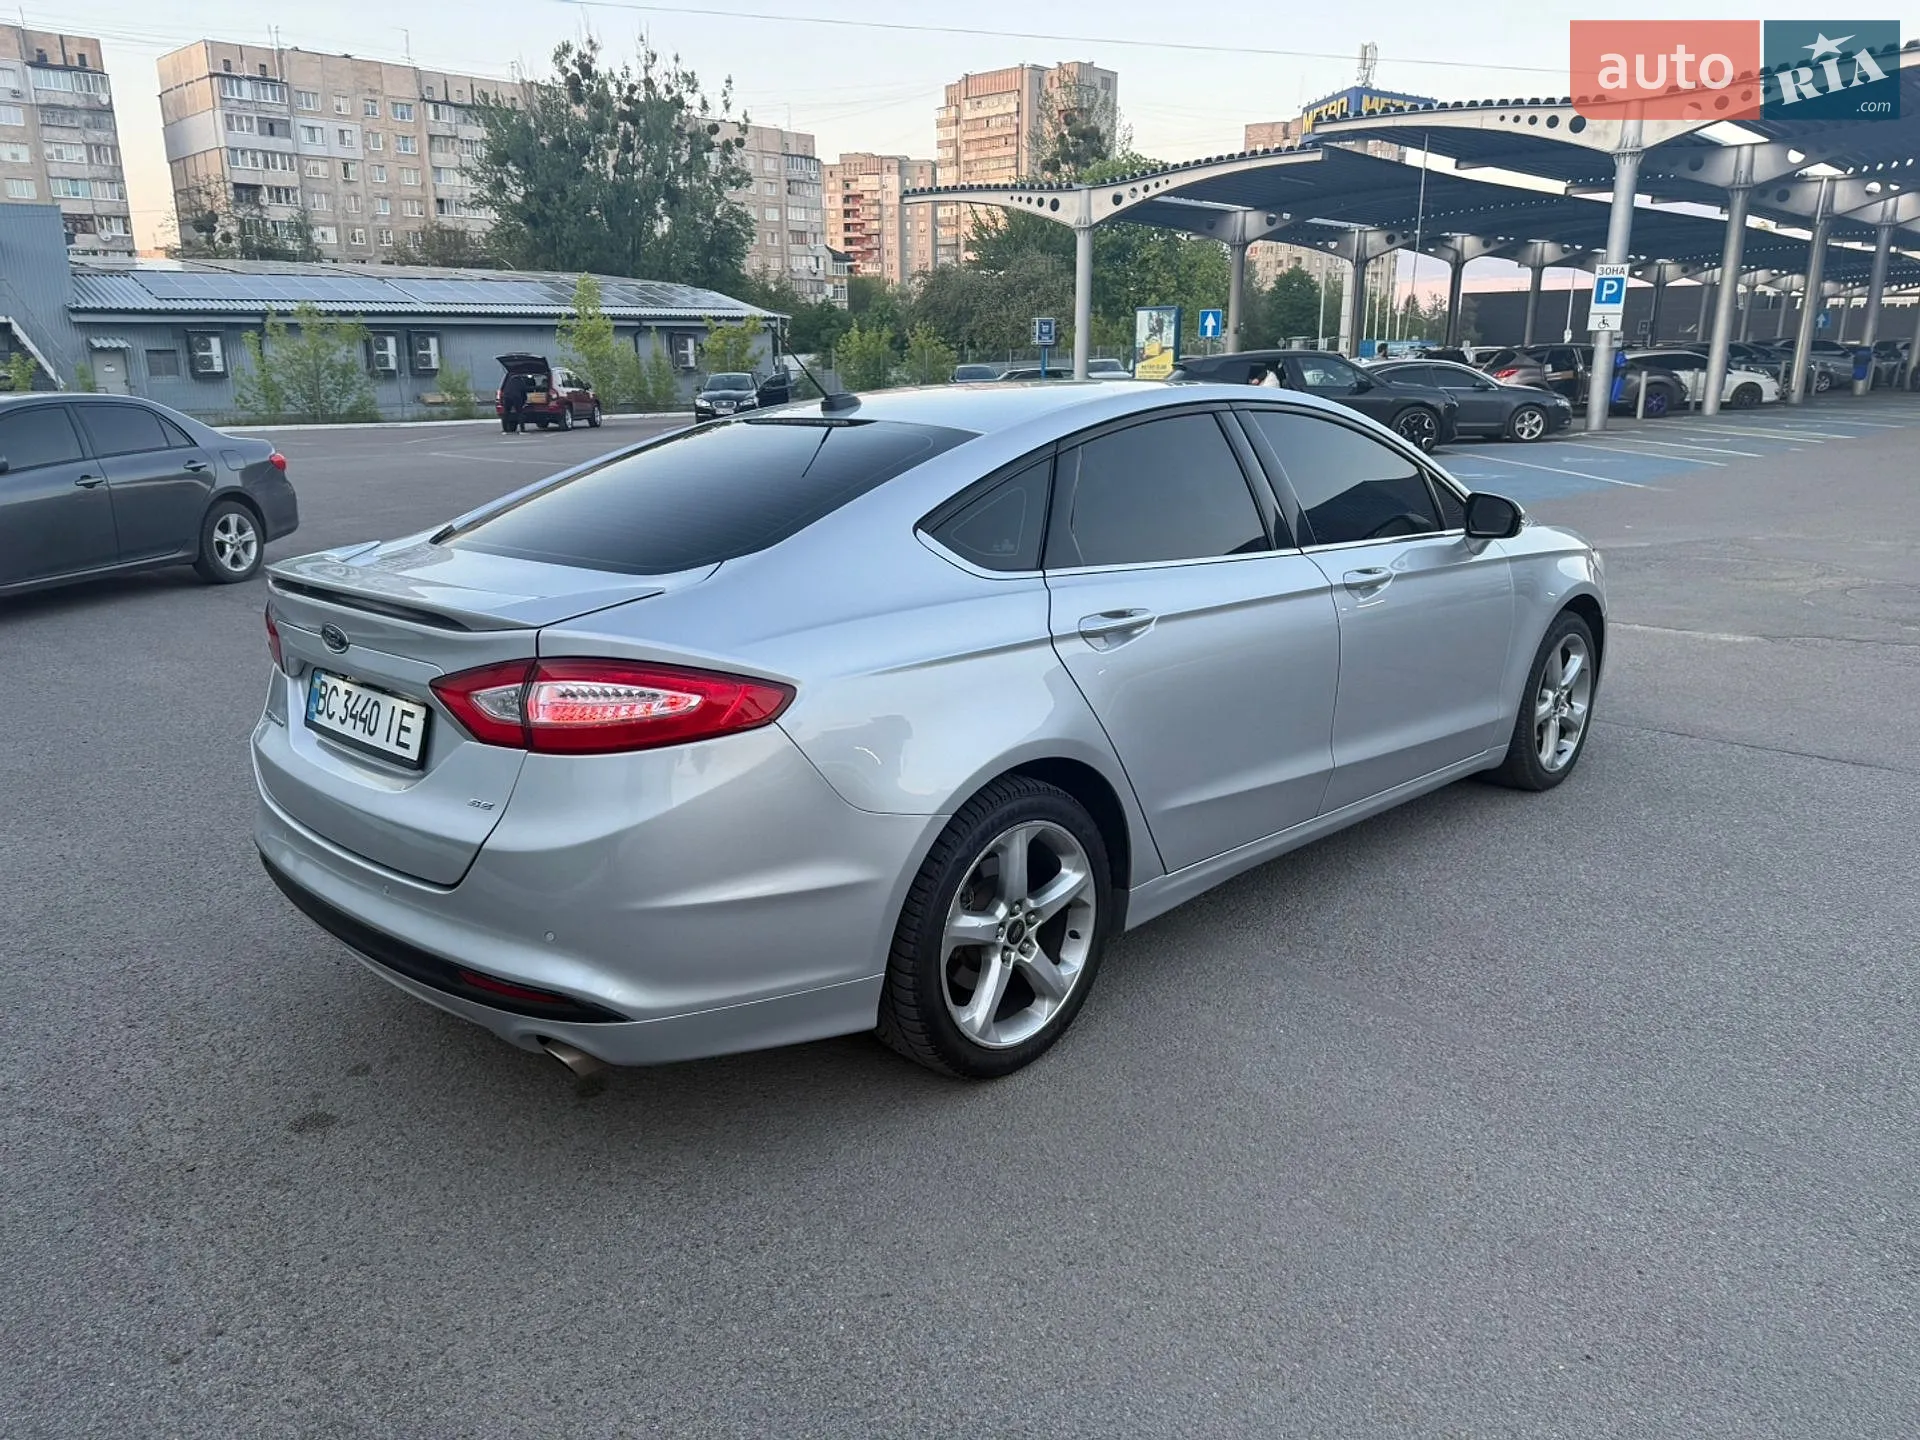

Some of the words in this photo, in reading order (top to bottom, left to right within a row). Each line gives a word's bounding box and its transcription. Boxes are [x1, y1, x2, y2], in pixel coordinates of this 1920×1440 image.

[1598, 266, 1626, 276] ЗОНА
[1601, 279, 1618, 302] P
[316, 680, 339, 720] BC
[339, 689, 381, 737] 3440
[386, 705, 415, 750] IE
